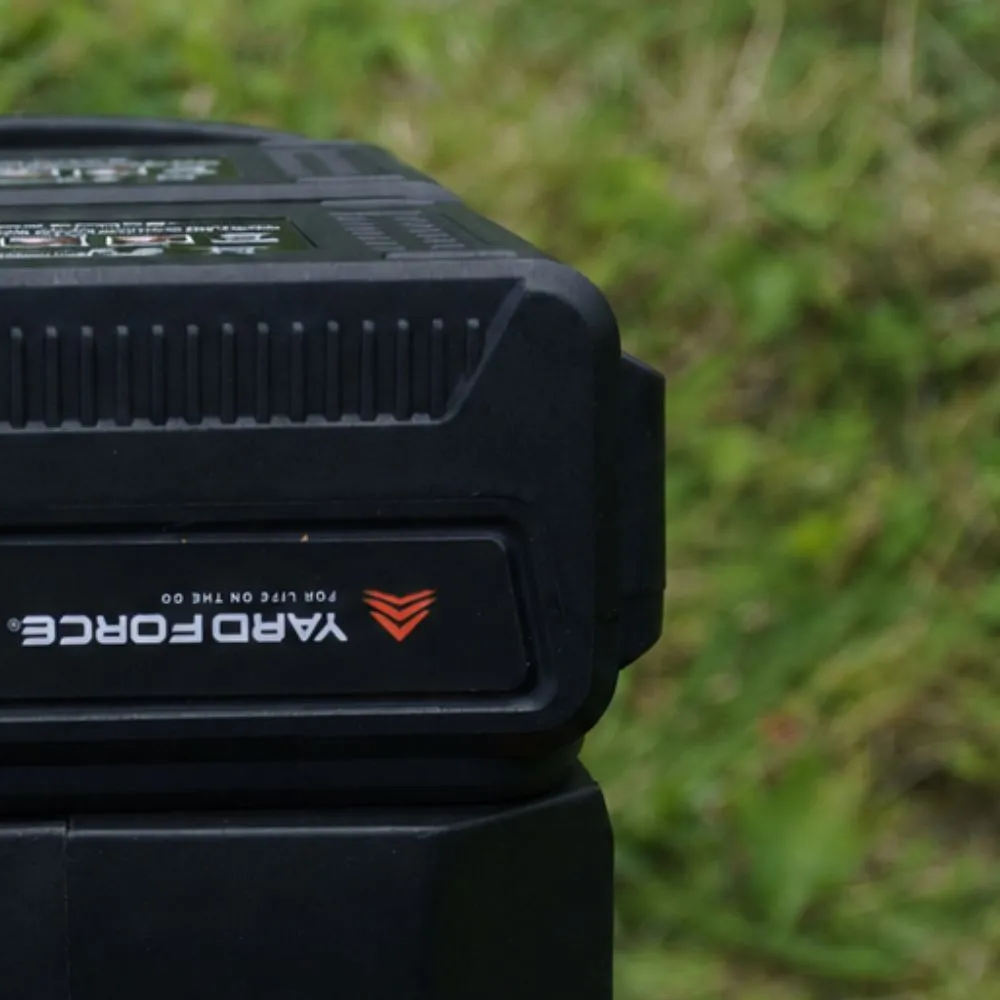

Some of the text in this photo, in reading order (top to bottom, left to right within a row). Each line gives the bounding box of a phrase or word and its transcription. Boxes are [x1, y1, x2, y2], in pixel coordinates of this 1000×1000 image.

[191, 593, 223, 604] THE
[229, 592, 253, 604] ON
[261, 592, 297, 603] LIFE
[304, 591, 337, 602] FOR
